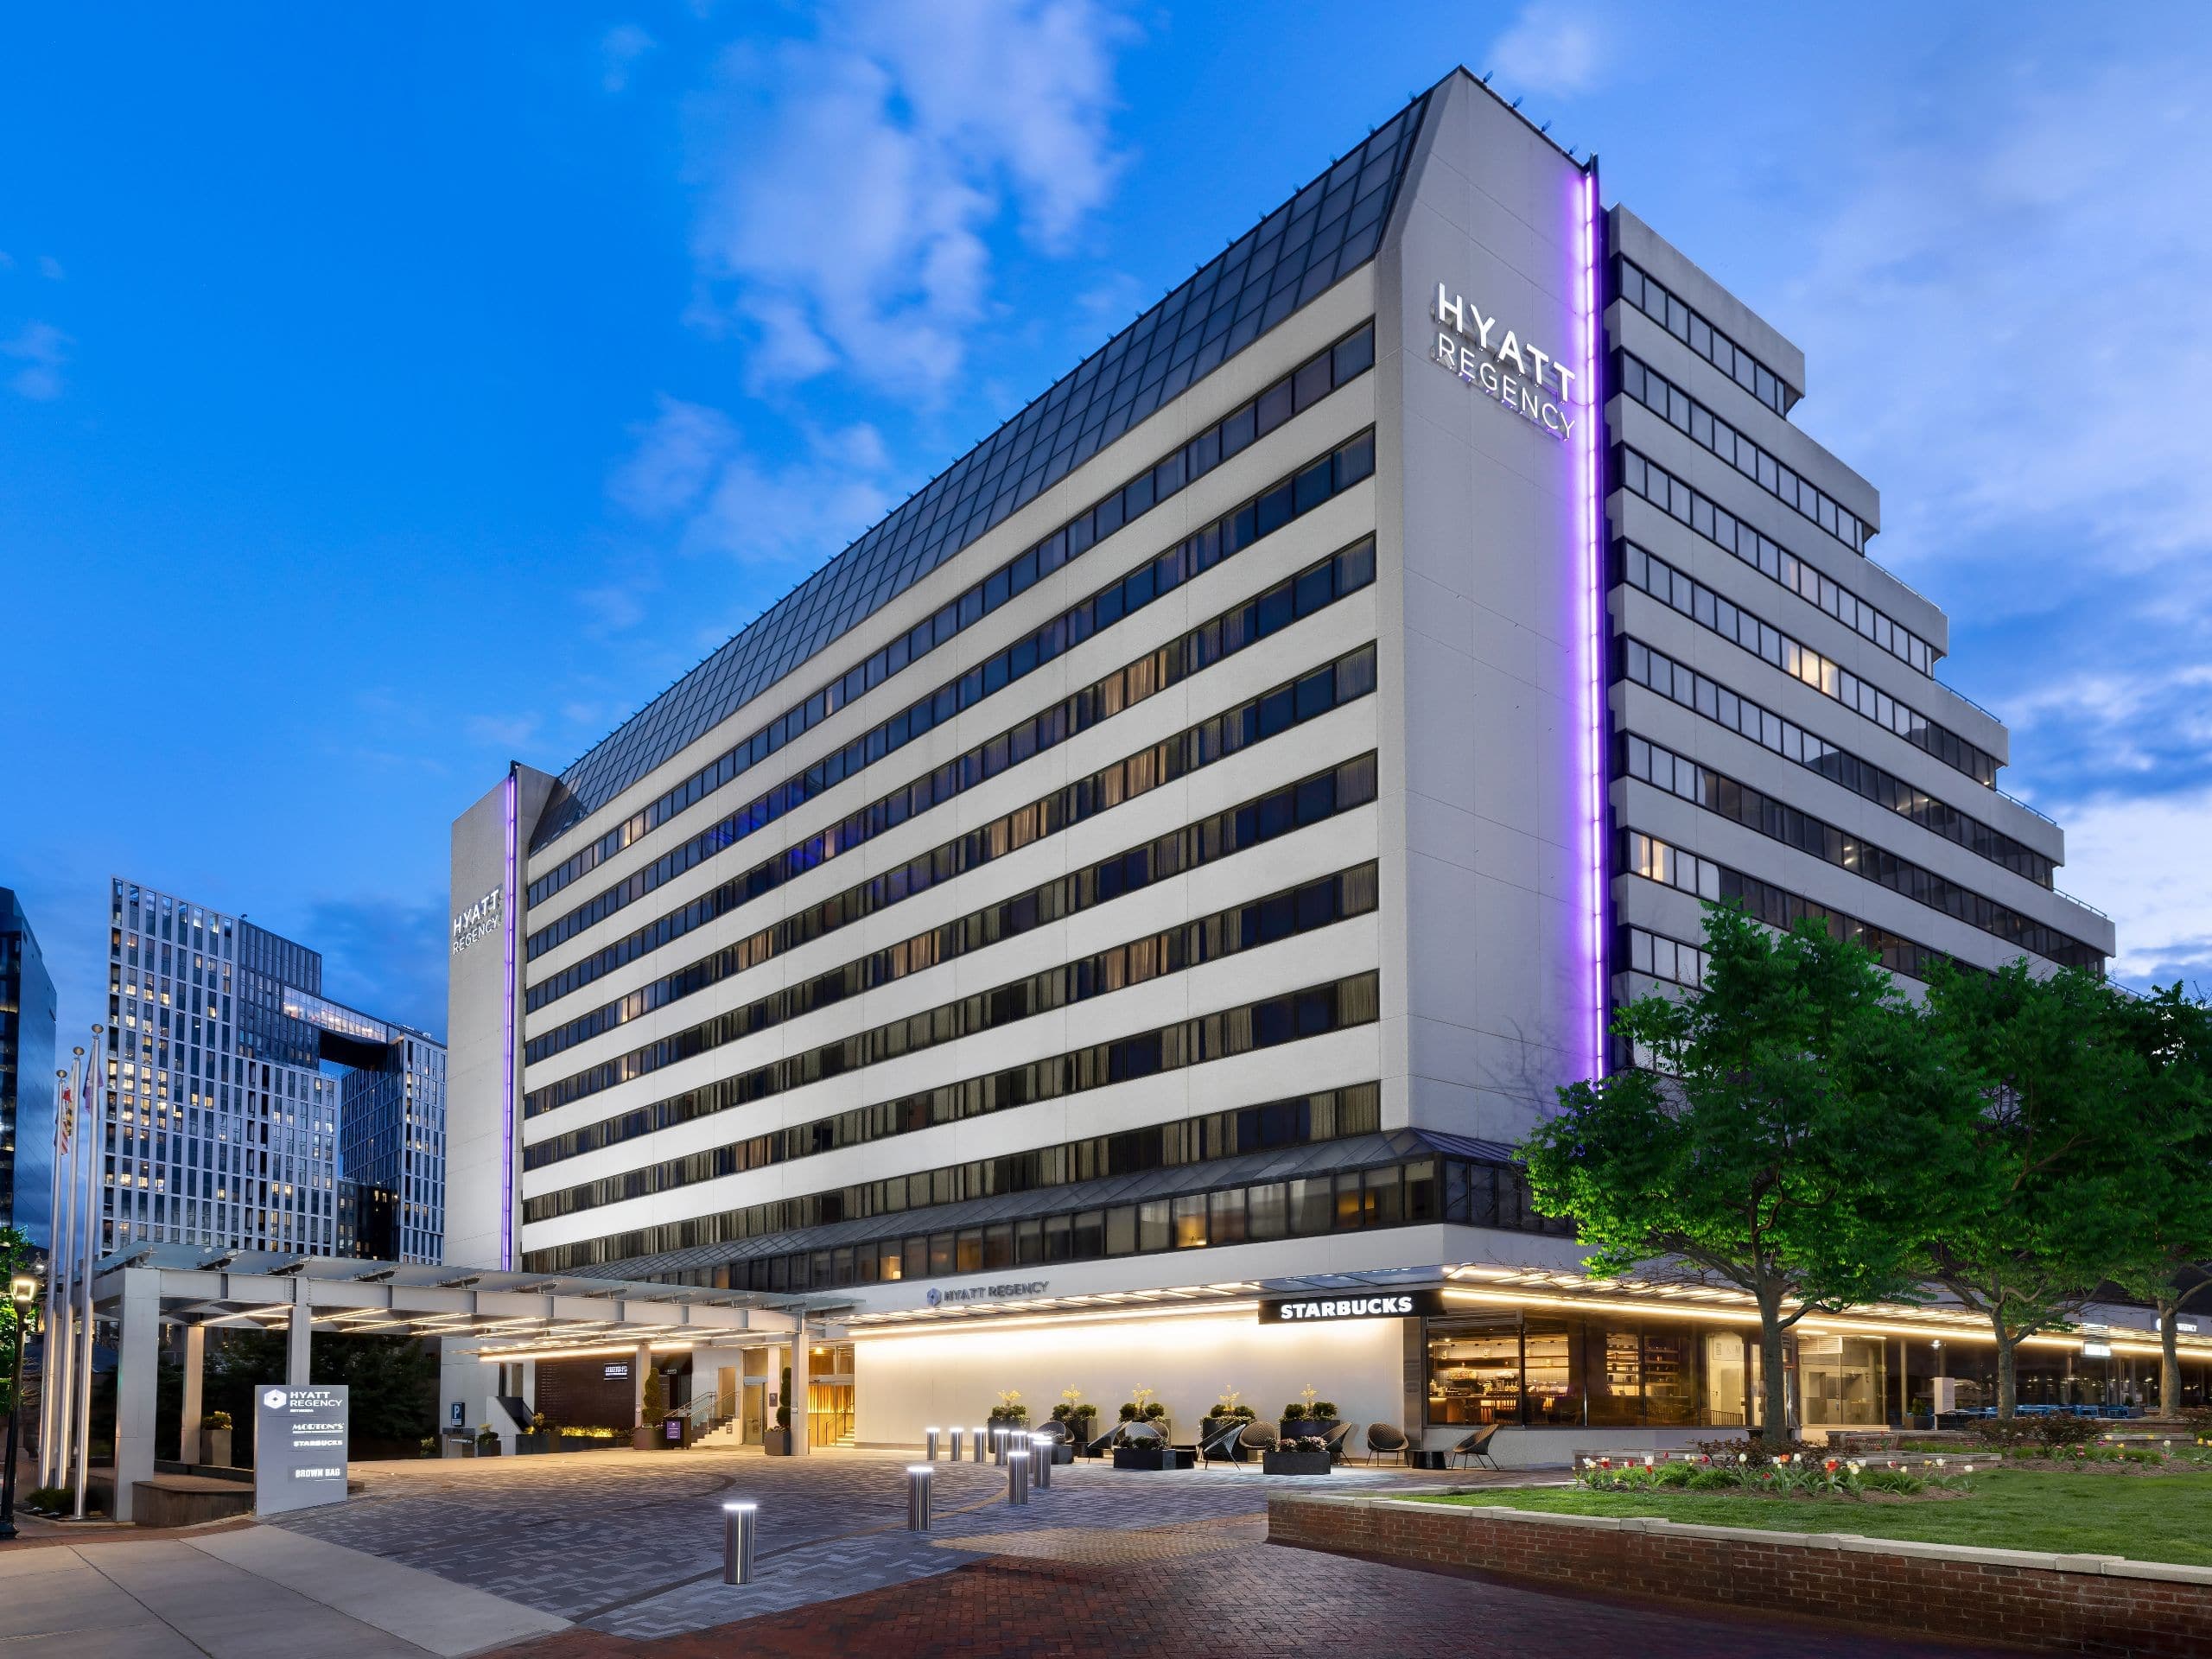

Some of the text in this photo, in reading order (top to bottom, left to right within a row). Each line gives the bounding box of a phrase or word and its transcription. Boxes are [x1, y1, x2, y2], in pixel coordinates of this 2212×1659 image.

[1438, 282, 1576, 403] HYATT
[1438, 332, 1576, 439] REGENCY
[453, 888, 499, 937] HYATT
[453, 914, 499, 956] REGENCY
[944, 1281, 1050, 1302] HYATT REGENCY
[1280, 1296, 1414, 1319] STARBUCKS
[296, 1467, 341, 1478] BROWN BAG
